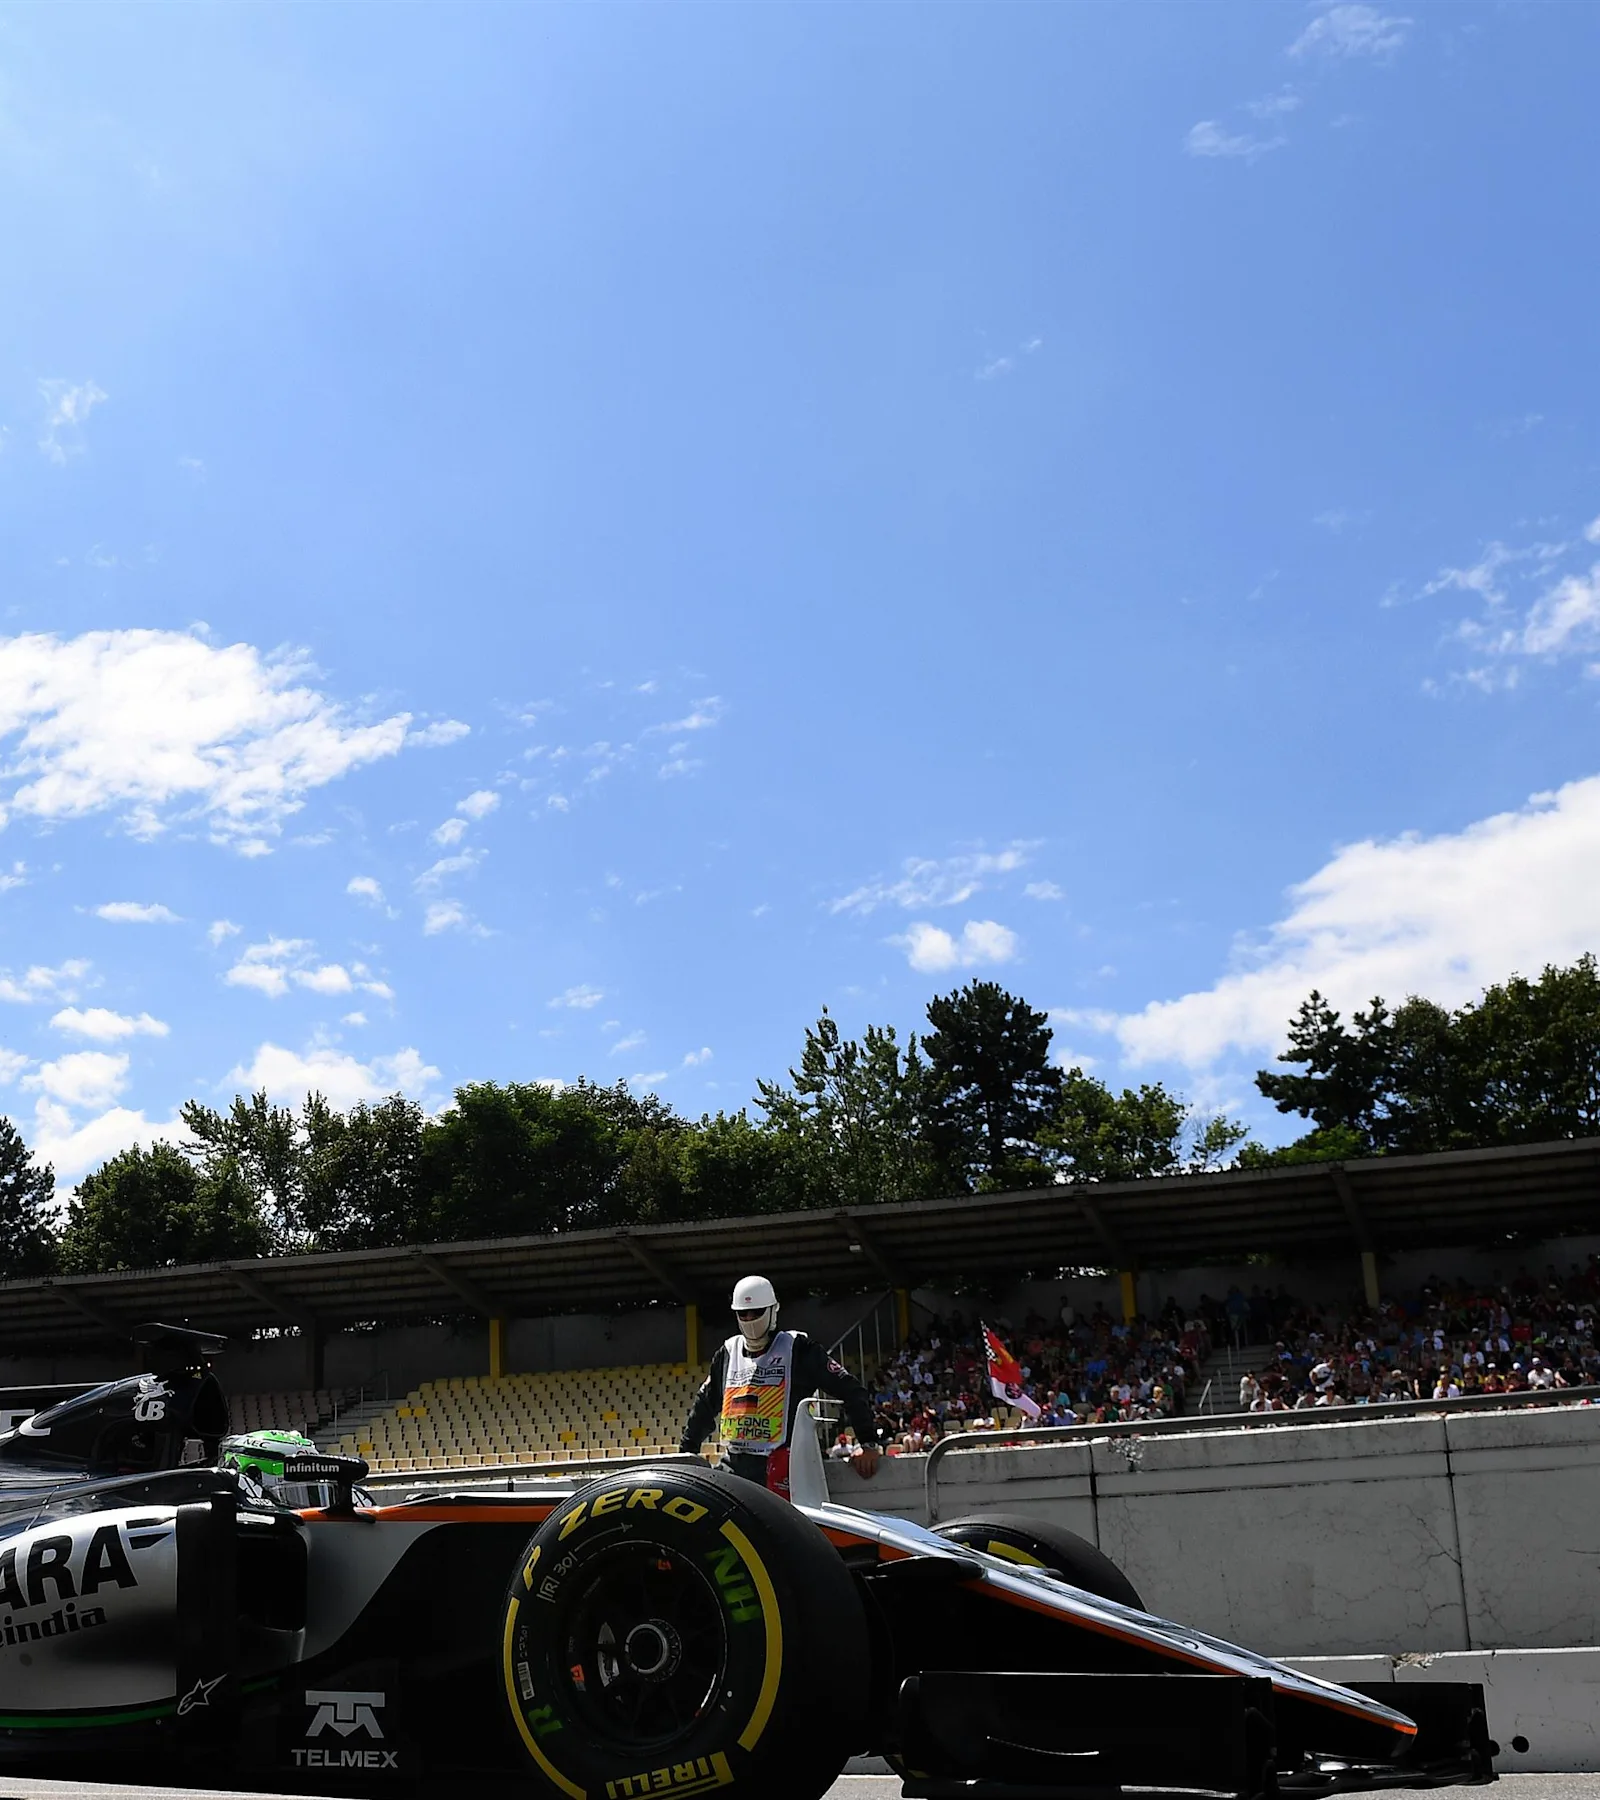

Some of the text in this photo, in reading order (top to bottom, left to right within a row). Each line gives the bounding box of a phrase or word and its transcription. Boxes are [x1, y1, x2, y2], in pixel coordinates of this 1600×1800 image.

[244, 1438, 271, 1449] NEC
[285, 1463, 340, 1474] infinitum
[523, 1488, 709, 1591] P ZERO
[290, 1748, 399, 1769] TELMEX
[605, 1751, 735, 1800] PIRELLI
